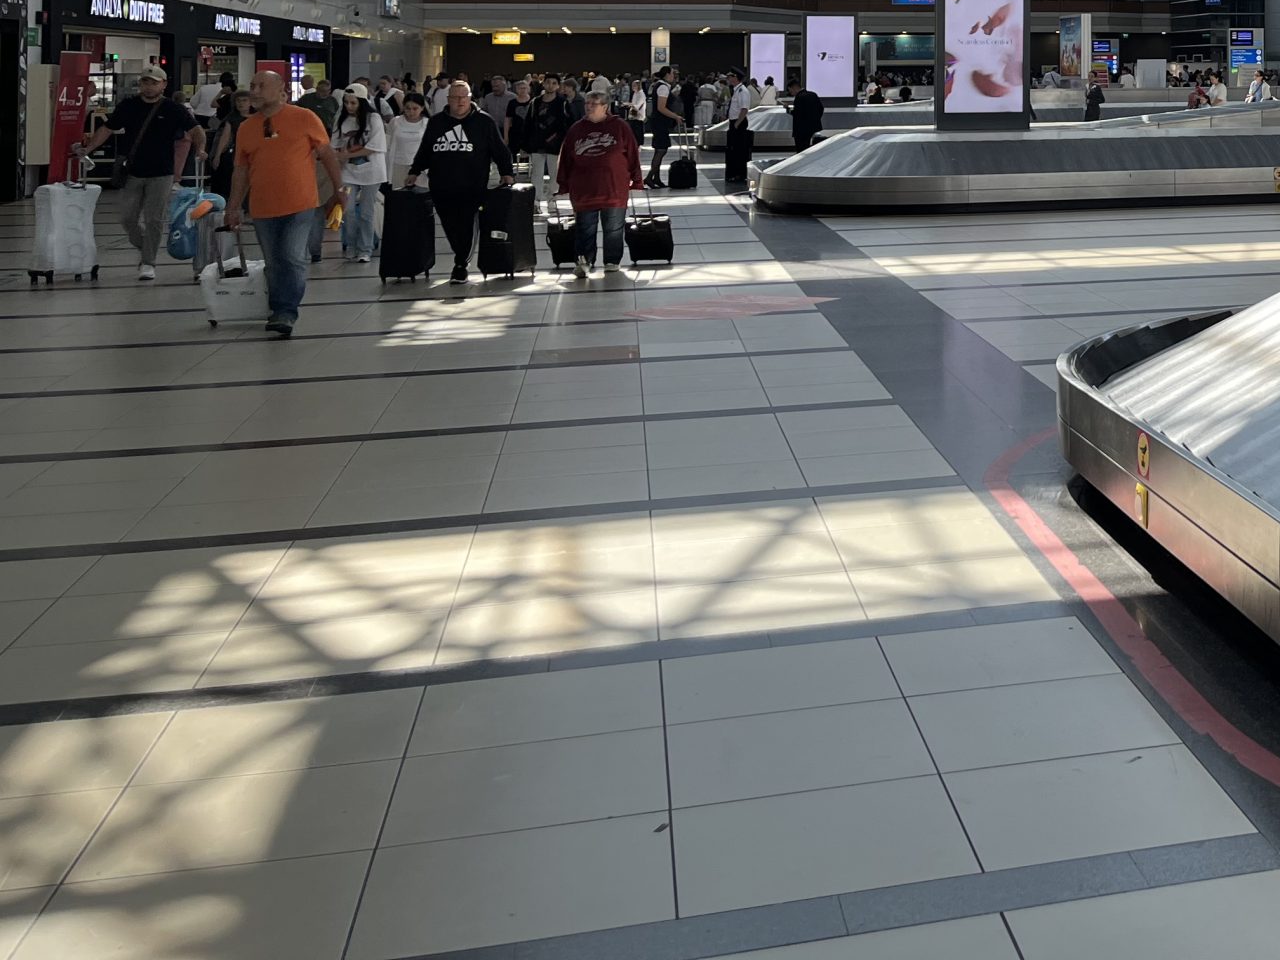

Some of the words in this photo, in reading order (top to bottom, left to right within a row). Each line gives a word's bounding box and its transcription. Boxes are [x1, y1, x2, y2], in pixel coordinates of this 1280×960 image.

[129, 0, 148, 22] DUTY
[148, 2, 165, 24] FREE
[59, 86, 67, 106] 4
[75, 86, 84, 106] 3
[432, 139, 474, 152] adidas
